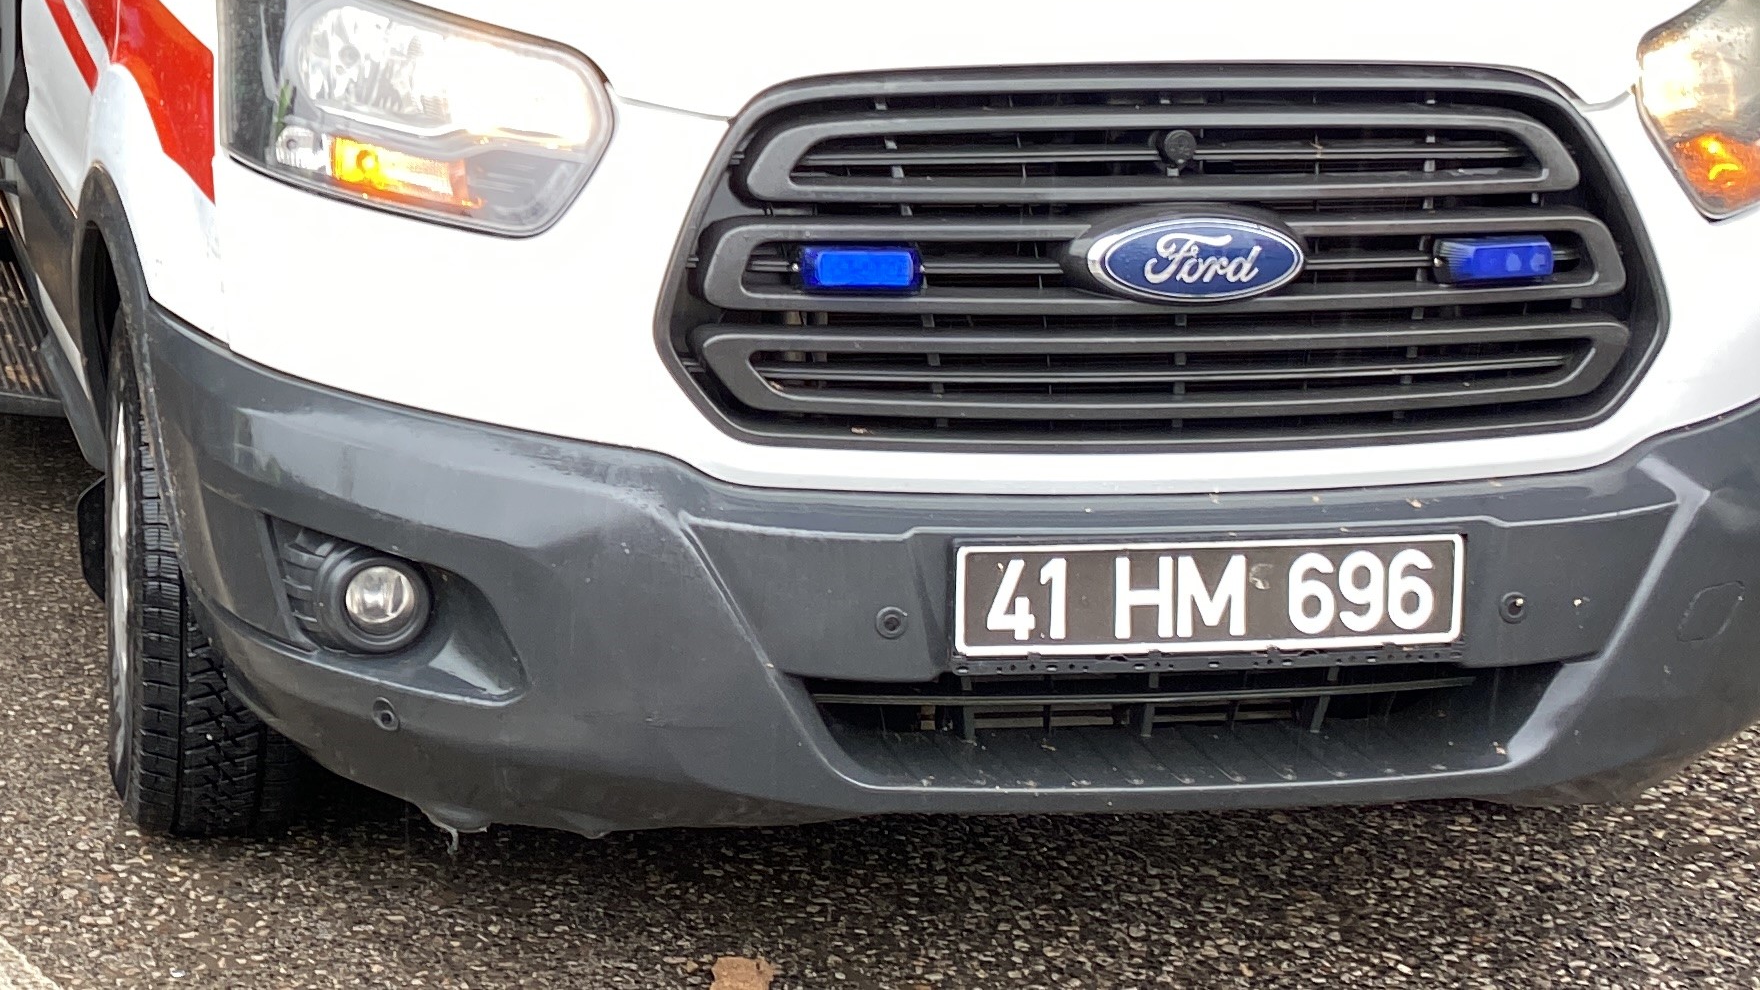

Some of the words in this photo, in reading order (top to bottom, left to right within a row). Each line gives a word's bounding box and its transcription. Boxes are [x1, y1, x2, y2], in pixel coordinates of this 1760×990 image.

[1143, 232, 1263, 285] Ford
[985, 556, 1068, 641] 41
[1114, 554, 1247, 640] HM
[1287, 548, 1435, 636] 696
